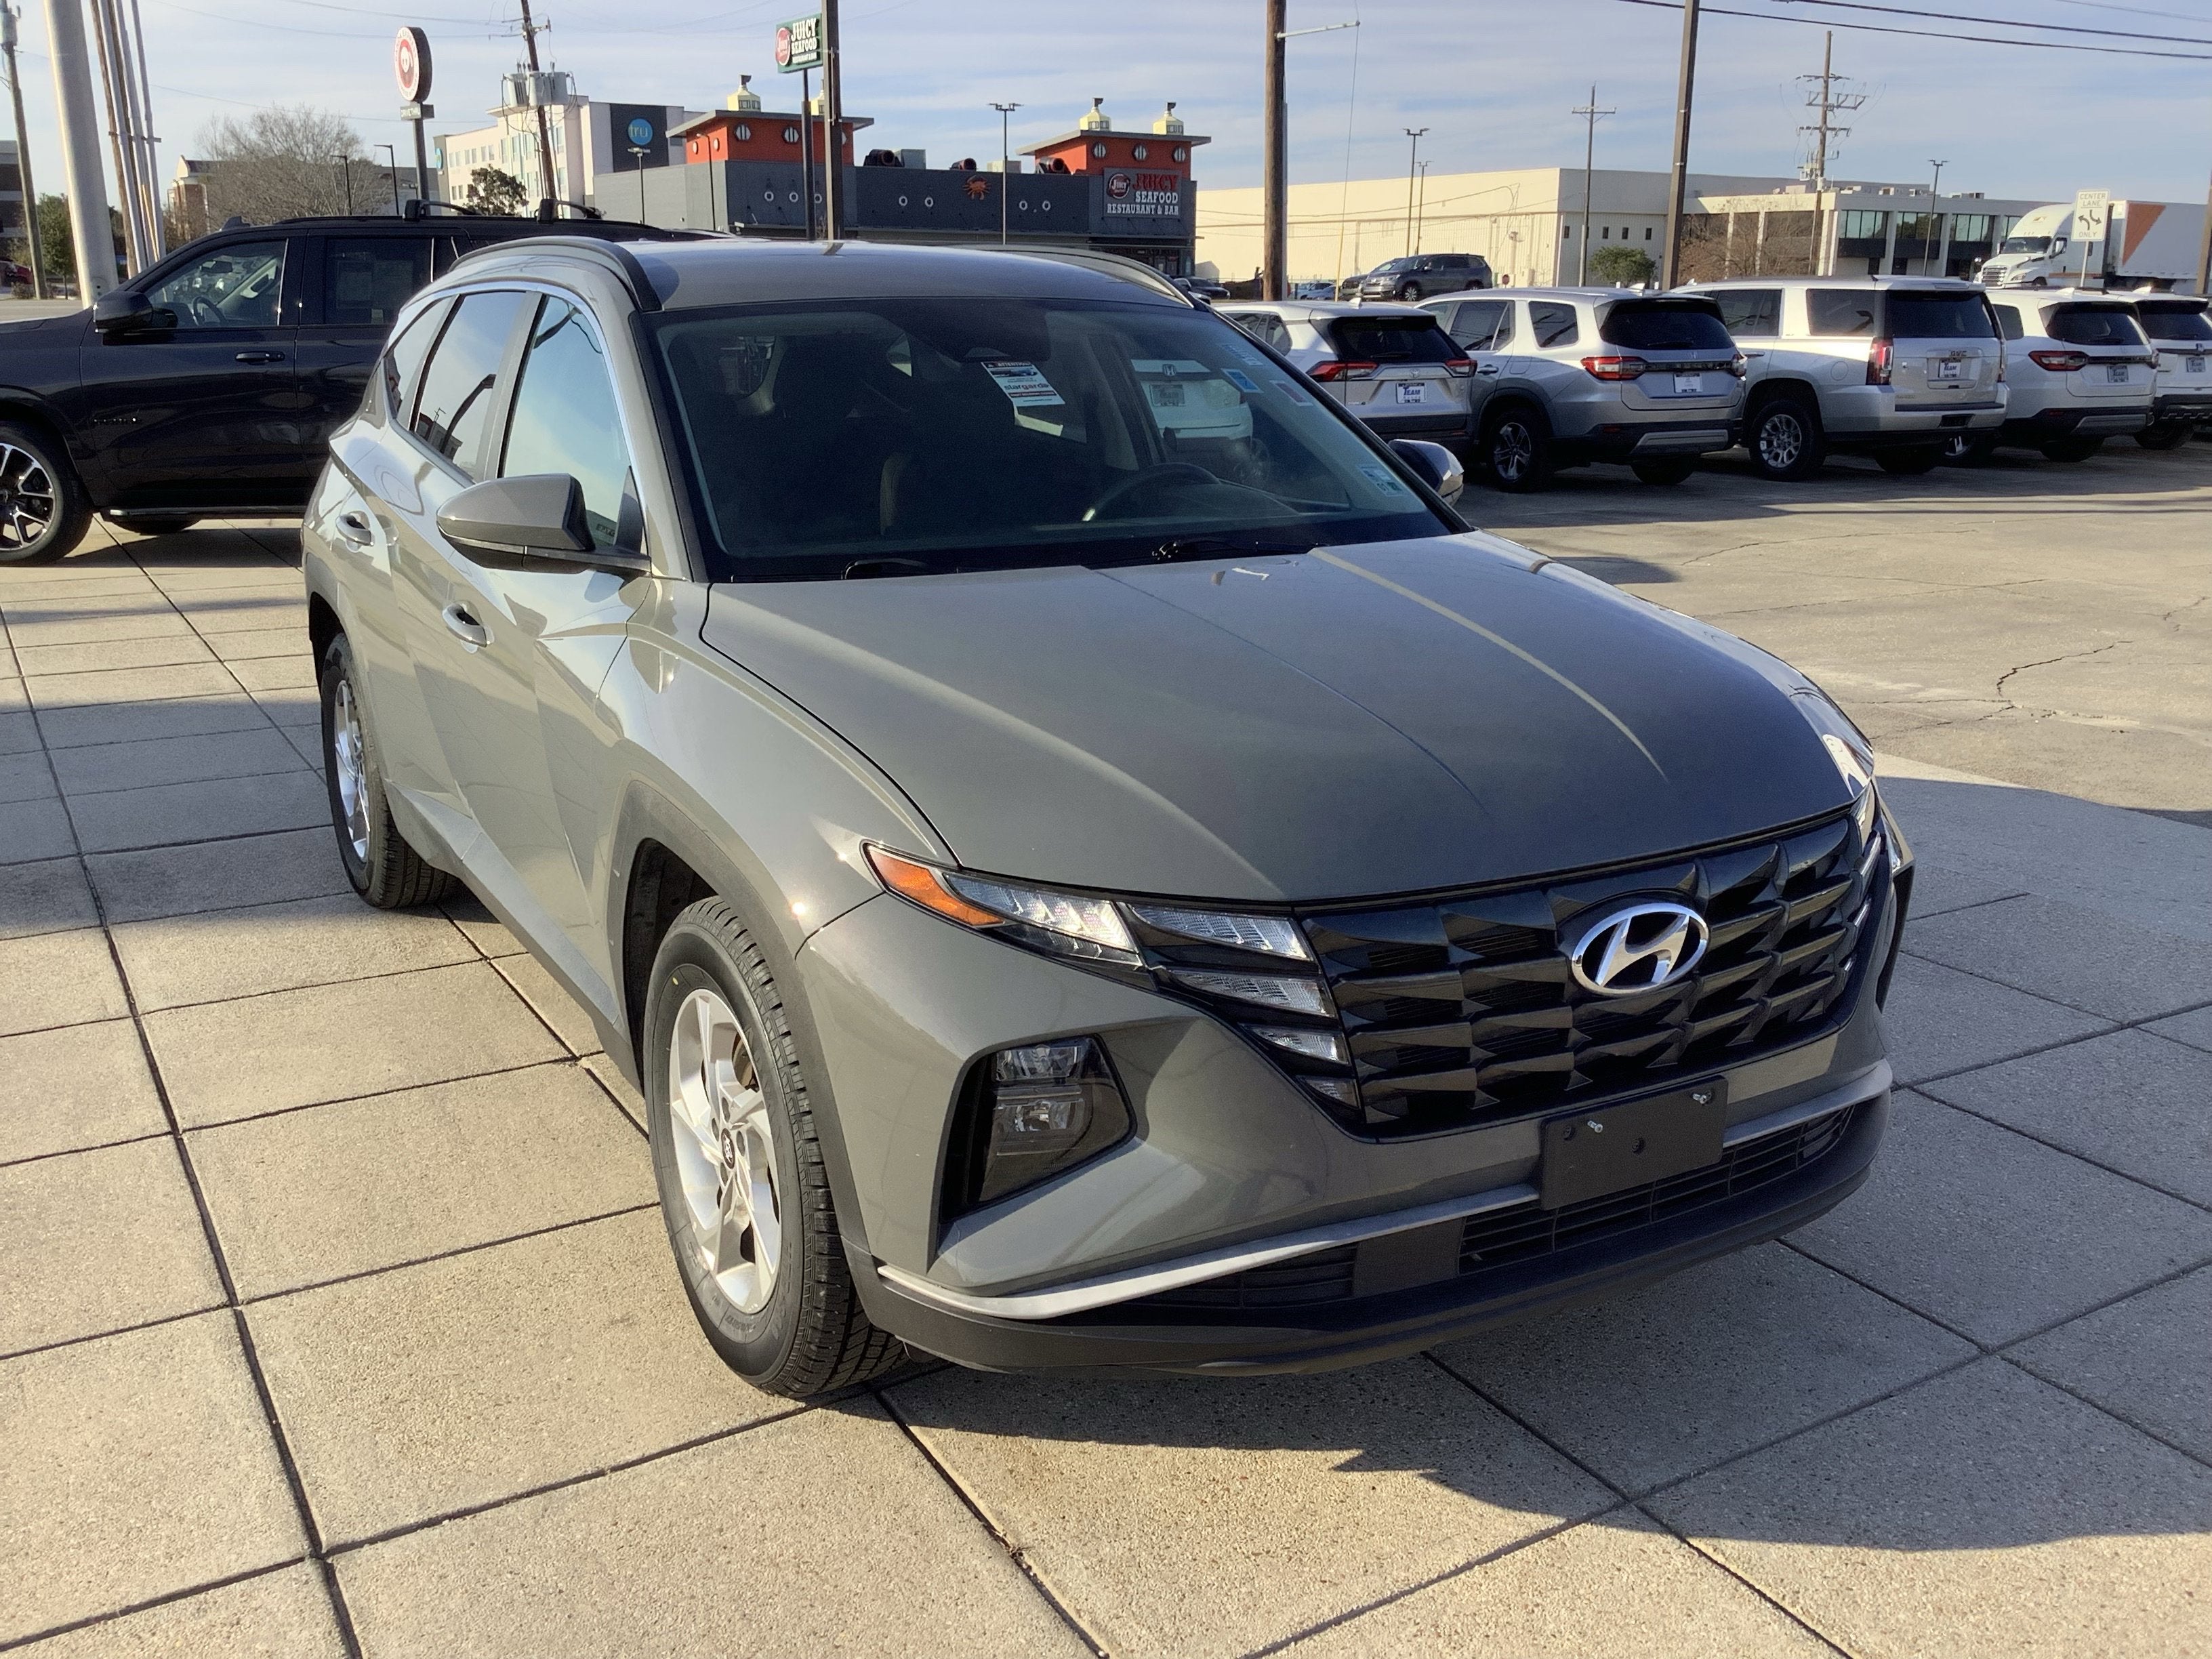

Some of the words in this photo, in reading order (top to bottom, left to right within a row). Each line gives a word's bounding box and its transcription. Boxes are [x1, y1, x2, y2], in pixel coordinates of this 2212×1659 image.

[791, 18, 817, 41] JUICY
[792, 37, 817, 54] SEAFOOD
[1132, 173, 1177, 191] JUICY
[1135, 191, 1179, 203] SEAFOOD
[1107, 204, 1155, 214] RESTAURANT
[1157, 205, 1162, 214] &
[1164, 205, 1179, 216] BAR
